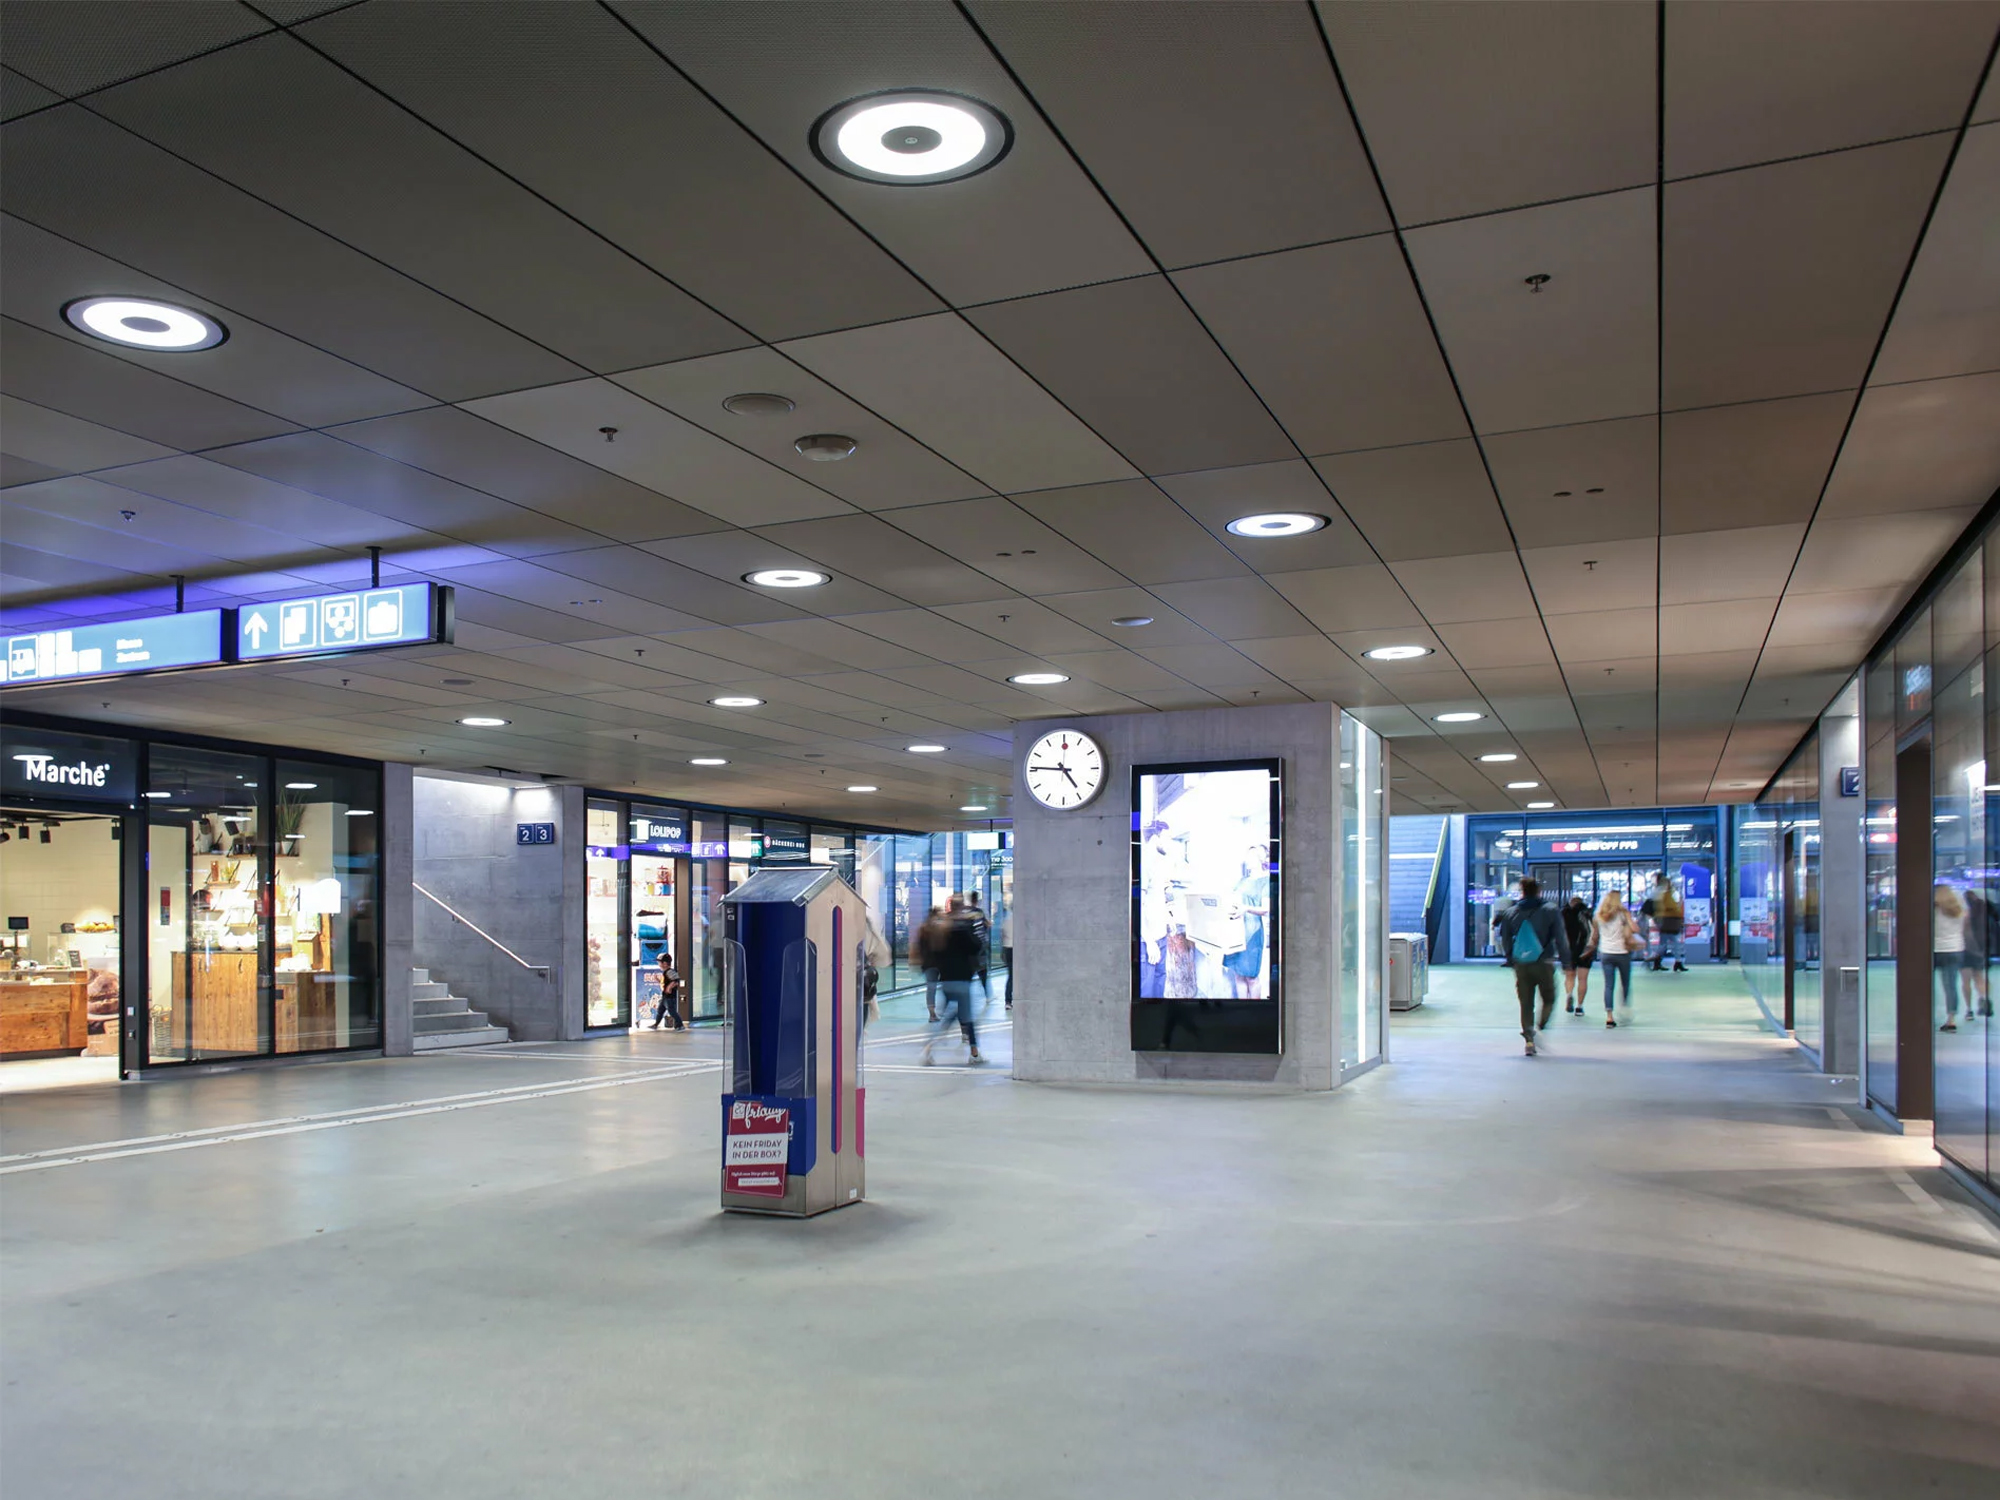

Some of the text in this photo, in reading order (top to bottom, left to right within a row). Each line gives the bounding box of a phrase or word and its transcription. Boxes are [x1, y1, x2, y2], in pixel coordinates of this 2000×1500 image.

[522, 830, 530, 841] 2
[540, 829, 548, 841] 3
[733, 1140, 782, 1149] KEIN FRIDAY
[732, 1150, 782, 1159] IN DER BOX?
